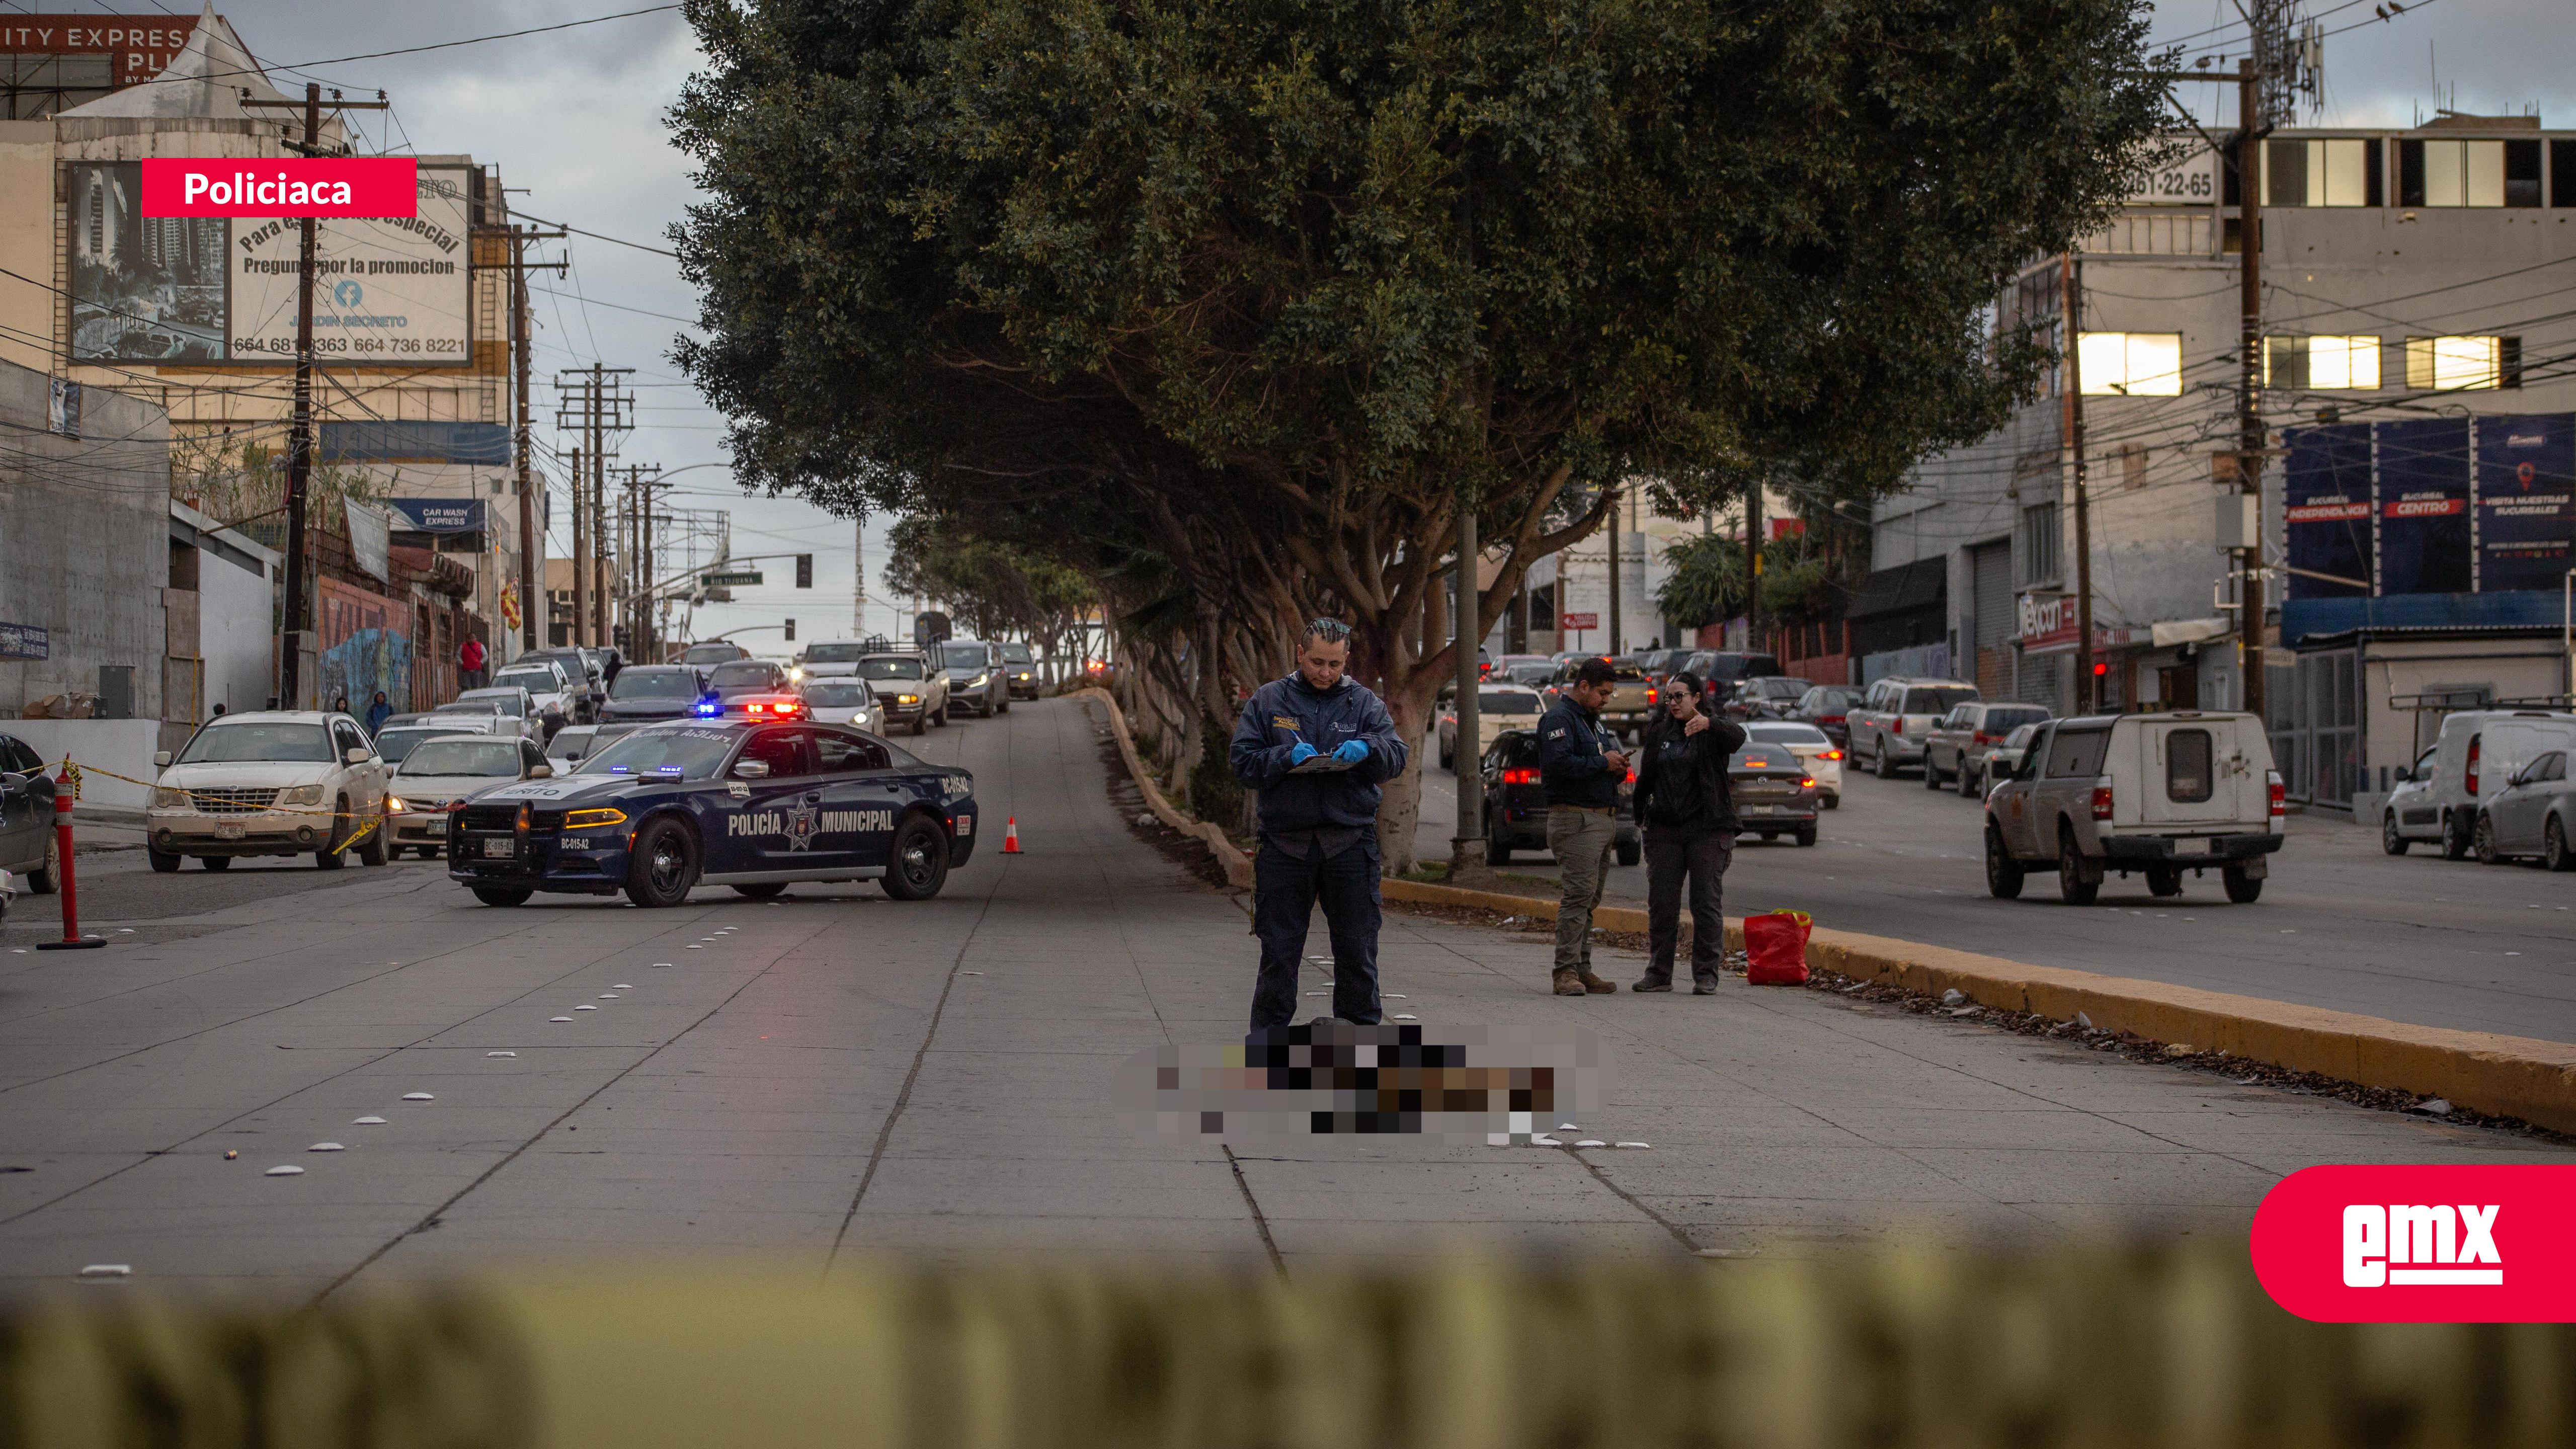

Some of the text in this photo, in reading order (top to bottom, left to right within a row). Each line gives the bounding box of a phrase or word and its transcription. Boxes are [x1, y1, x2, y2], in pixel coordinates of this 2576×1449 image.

[6, 28, 195, 47] ITY EXPRES
[239, 220, 282, 253] Para
[320, 261, 347, 275] por
[351, 258, 364, 273] la
[368, 258, 455, 275] promocion
[343, 315, 408, 328] SECRETO
[234, 338, 265, 352] 664
[354, 338, 385, 352] 664
[390, 338, 421, 352] 736
[426, 339, 465, 353] 8221
[2485, 496, 2515, 506] VISITA
[423, 508, 468, 517] CAR WASH
[2397, 501, 2450, 515] CENTRO
[2494, 505, 2560, 516] SUCURSALES
[426, 517, 465, 525] EXPRESS
[1550, 729, 1565, 738] AEI
[729, 810, 894, 836] POLICÍA MUNICIPAL
[485, 841, 513, 851] BC-015-A2
[561, 838, 589, 849] BC-015-A2
